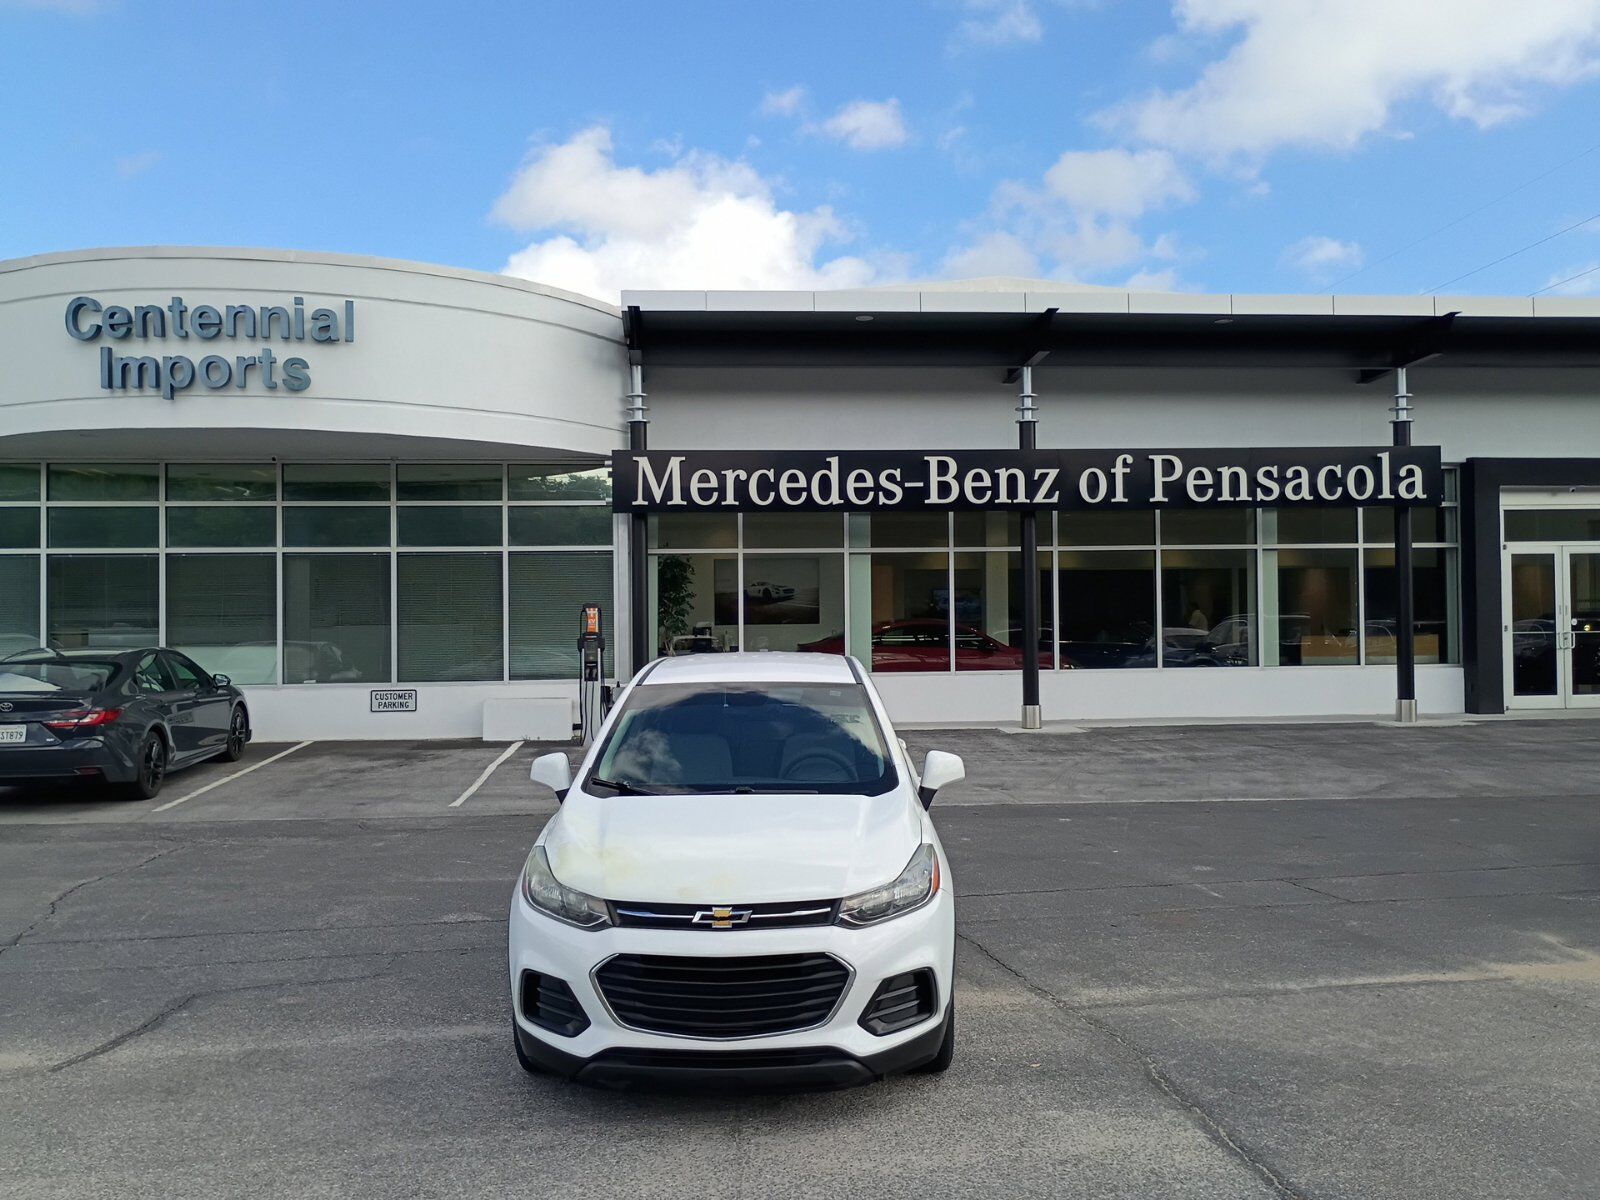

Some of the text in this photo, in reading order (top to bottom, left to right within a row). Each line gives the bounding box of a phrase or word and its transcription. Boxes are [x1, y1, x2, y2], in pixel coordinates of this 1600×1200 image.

[65, 296, 354, 342] Centennial
[100, 346, 311, 400] Imports
[632, 452, 1427, 505] Mercedes-Benz of Pensacola
[374, 692, 413, 700] CUSTOMER
[378, 701, 409, 709] PARKING
